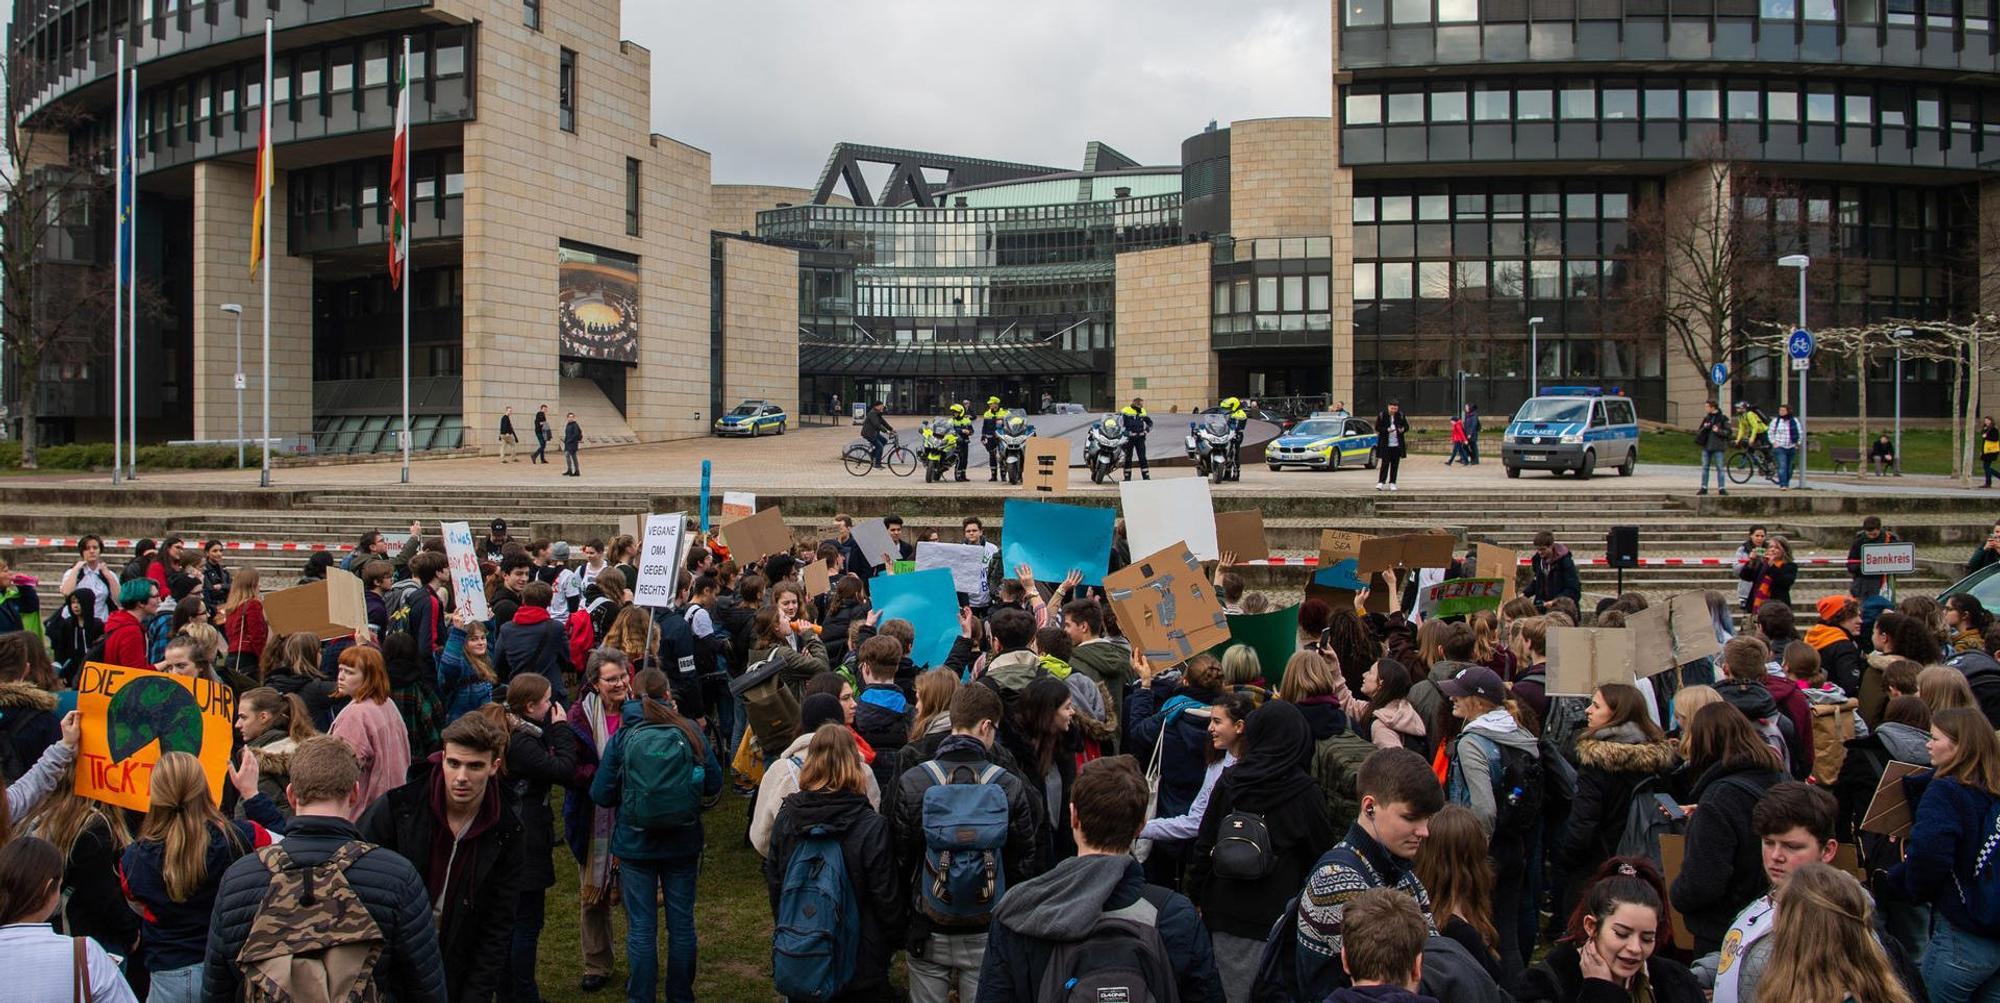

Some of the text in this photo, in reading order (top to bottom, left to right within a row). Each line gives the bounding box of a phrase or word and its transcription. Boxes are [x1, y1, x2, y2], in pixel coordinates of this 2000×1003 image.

[648, 526, 676, 536] VEGANE
[1332, 531, 1352, 541] LIKE
[651, 545, 666, 556] OMA
[1334, 541, 1351, 550] SEA
[463, 552, 478, 573] es
[1866, 553, 1910, 565] Bannkreis
[644, 565, 667, 576] GEGEN
[461, 575, 481, 597] spät
[639, 584, 666, 595] RECHTS
[81, 666, 232, 723] DIE UHR
